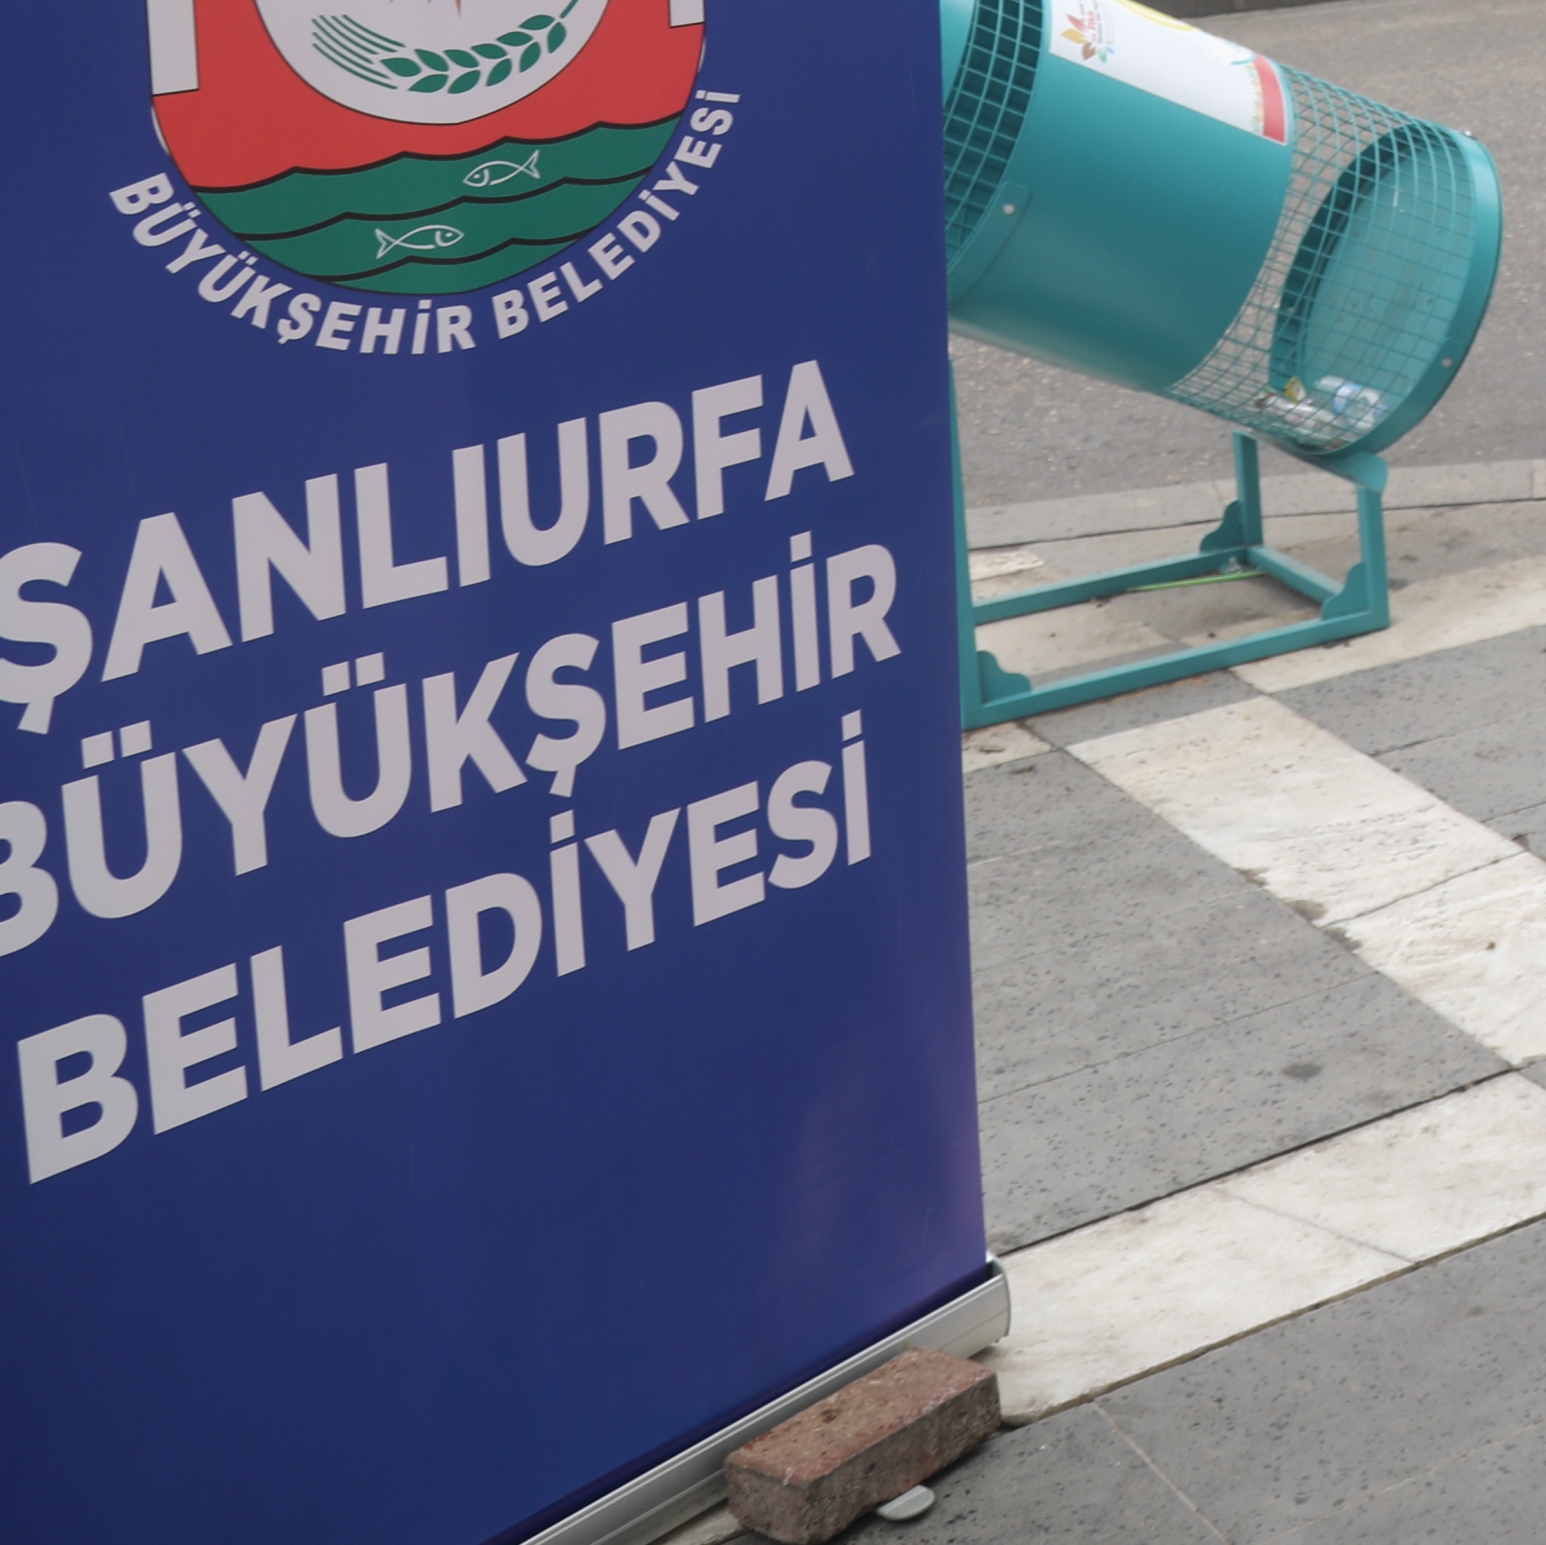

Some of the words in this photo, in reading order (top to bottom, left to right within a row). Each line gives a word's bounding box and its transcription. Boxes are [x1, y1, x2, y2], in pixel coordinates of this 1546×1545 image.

[109, 173, 475, 355] BÜYÜKŞEHİR
[492, 88, 741, 338] BELEDİYESİ
[0, 360, 854, 734] ŞANLIURFA
[0, 531, 902, 957] BÜYÜKŞEHİR
[16, 709, 872, 1185] BELEDİYESİ
